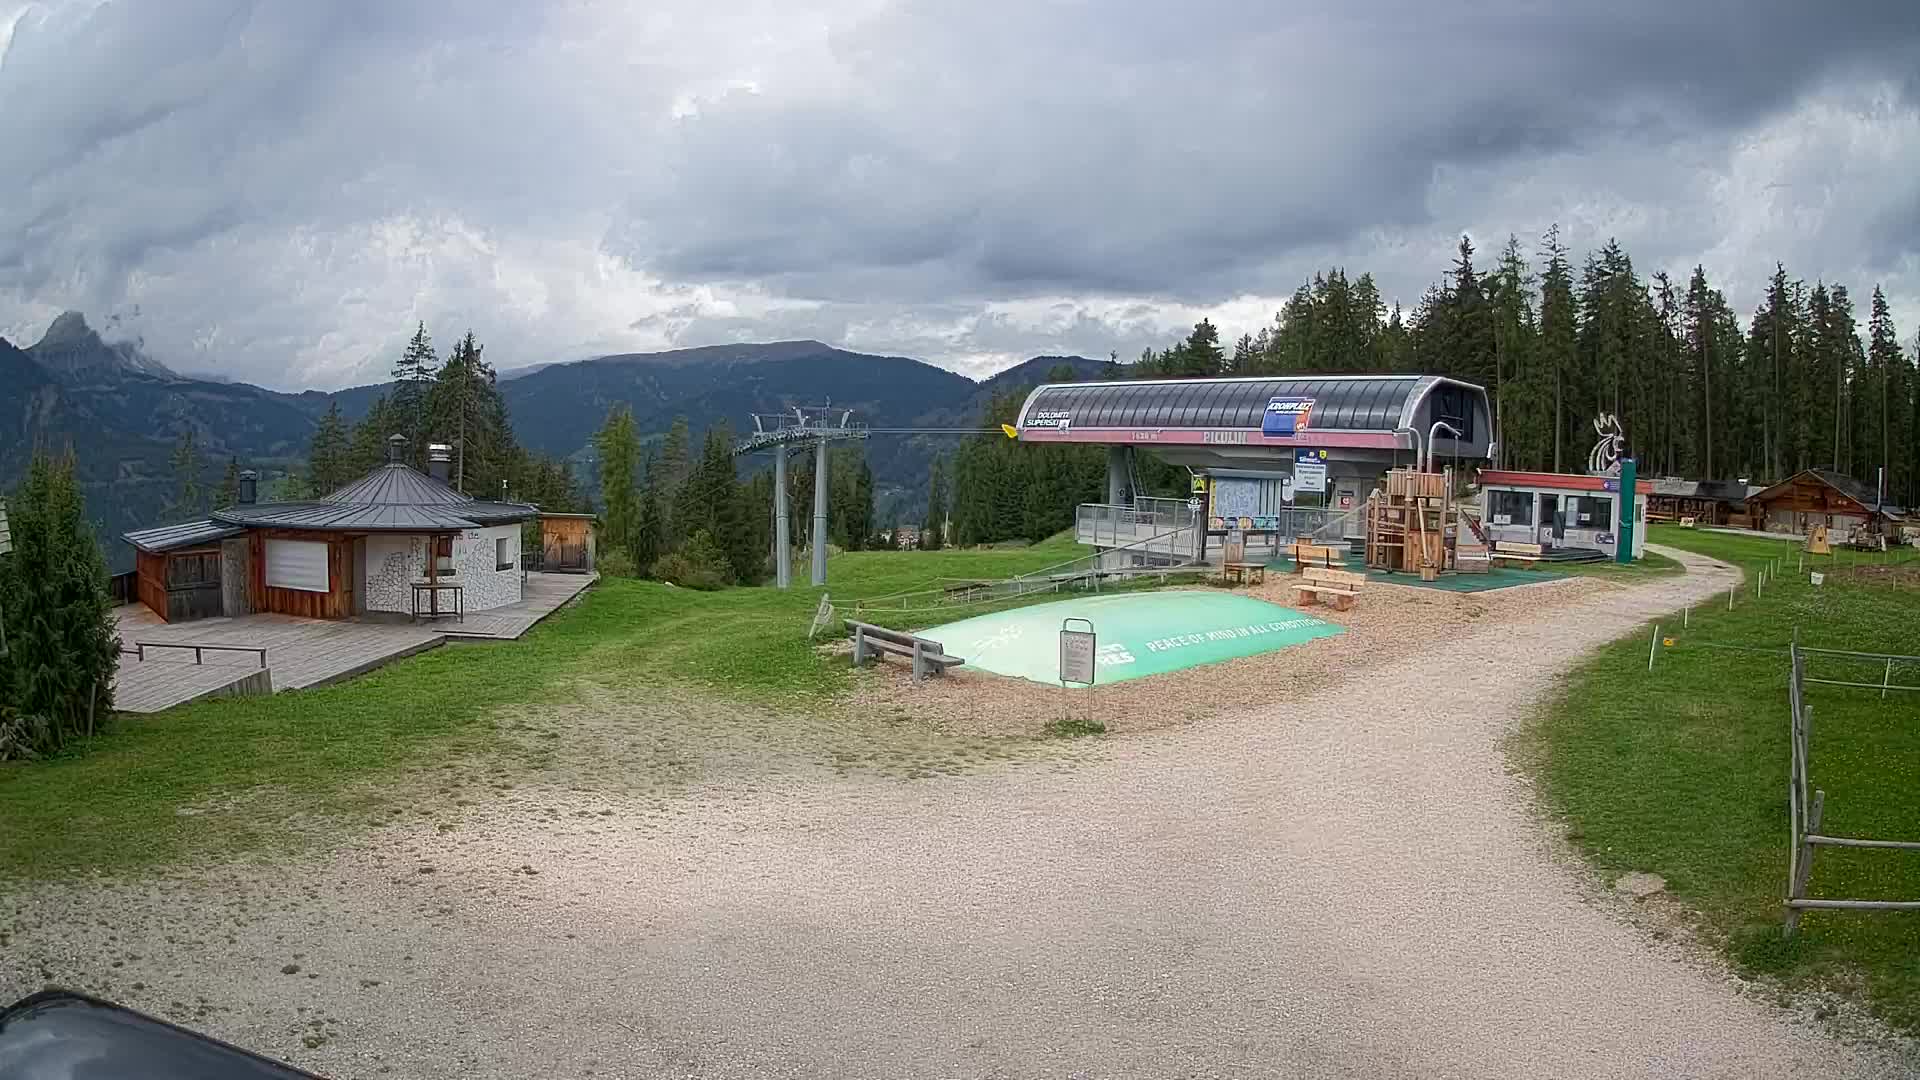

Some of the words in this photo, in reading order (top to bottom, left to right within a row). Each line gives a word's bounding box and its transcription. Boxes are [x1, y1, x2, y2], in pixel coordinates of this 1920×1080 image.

[1037, 411, 1070, 419] DOLOMITI
[1203, 431, 1248, 444] PICULIN
[1145, 635, 1190, 652] PEACE
[1188, 632, 1205, 644] OF
[1205, 629, 1237, 641] MIND
[1236, 626, 1250, 637] IN
[1248, 625, 1270, 635] ALL
